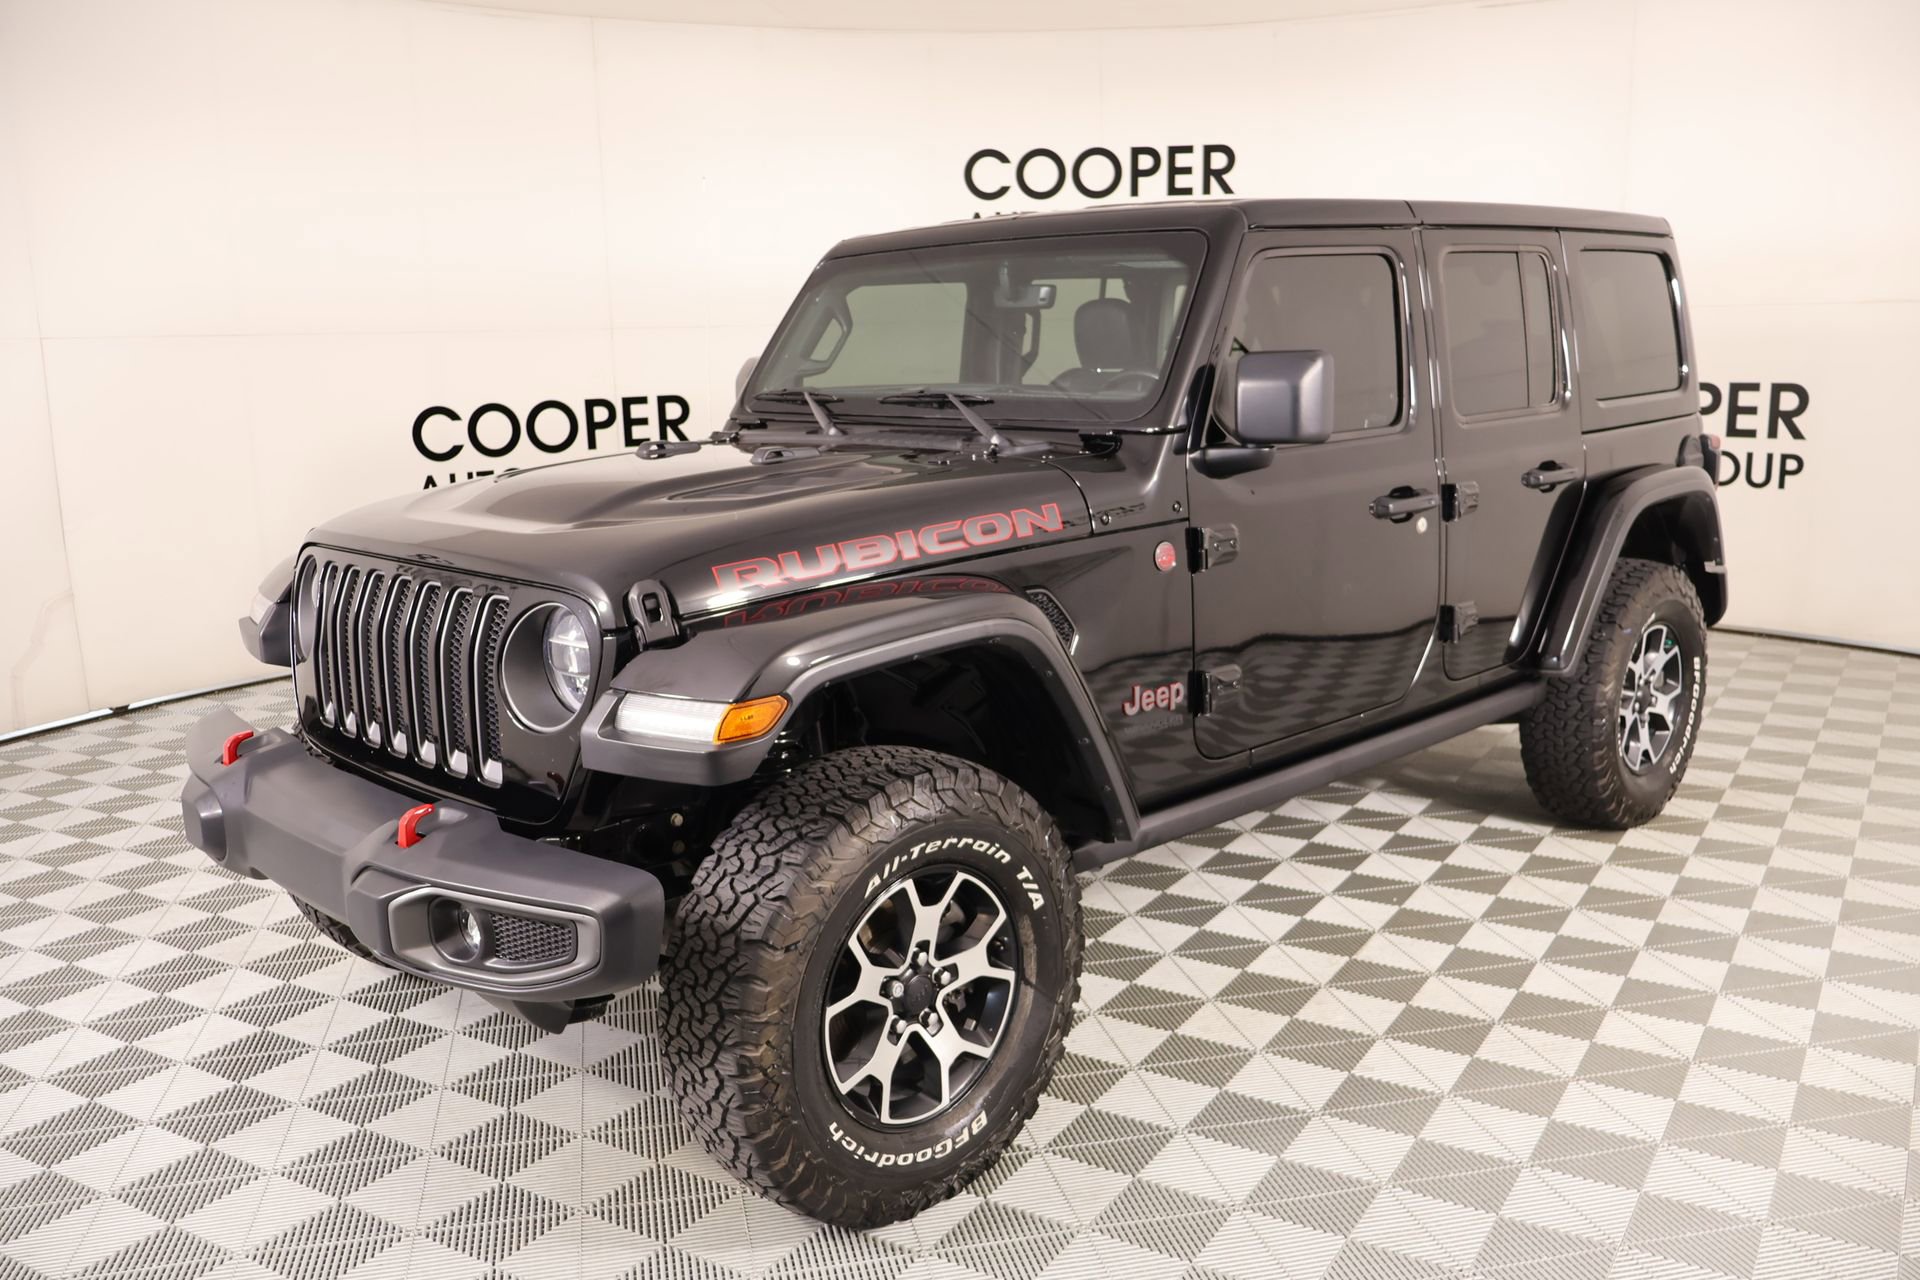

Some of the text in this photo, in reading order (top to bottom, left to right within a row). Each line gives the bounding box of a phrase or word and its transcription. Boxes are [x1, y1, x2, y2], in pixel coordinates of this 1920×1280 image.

[964, 144, 1235, 200] COOPER
[412, 395, 690, 462] COOPER
[712, 503, 1064, 592] RUBICON
[1122, 682, 1184, 717] Jeep
[1668, 656, 1700, 775] BFGoodrich
[864, 837, 1012, 898] All-Terrain
[828, 1109, 989, 1168] BFGoodrich
